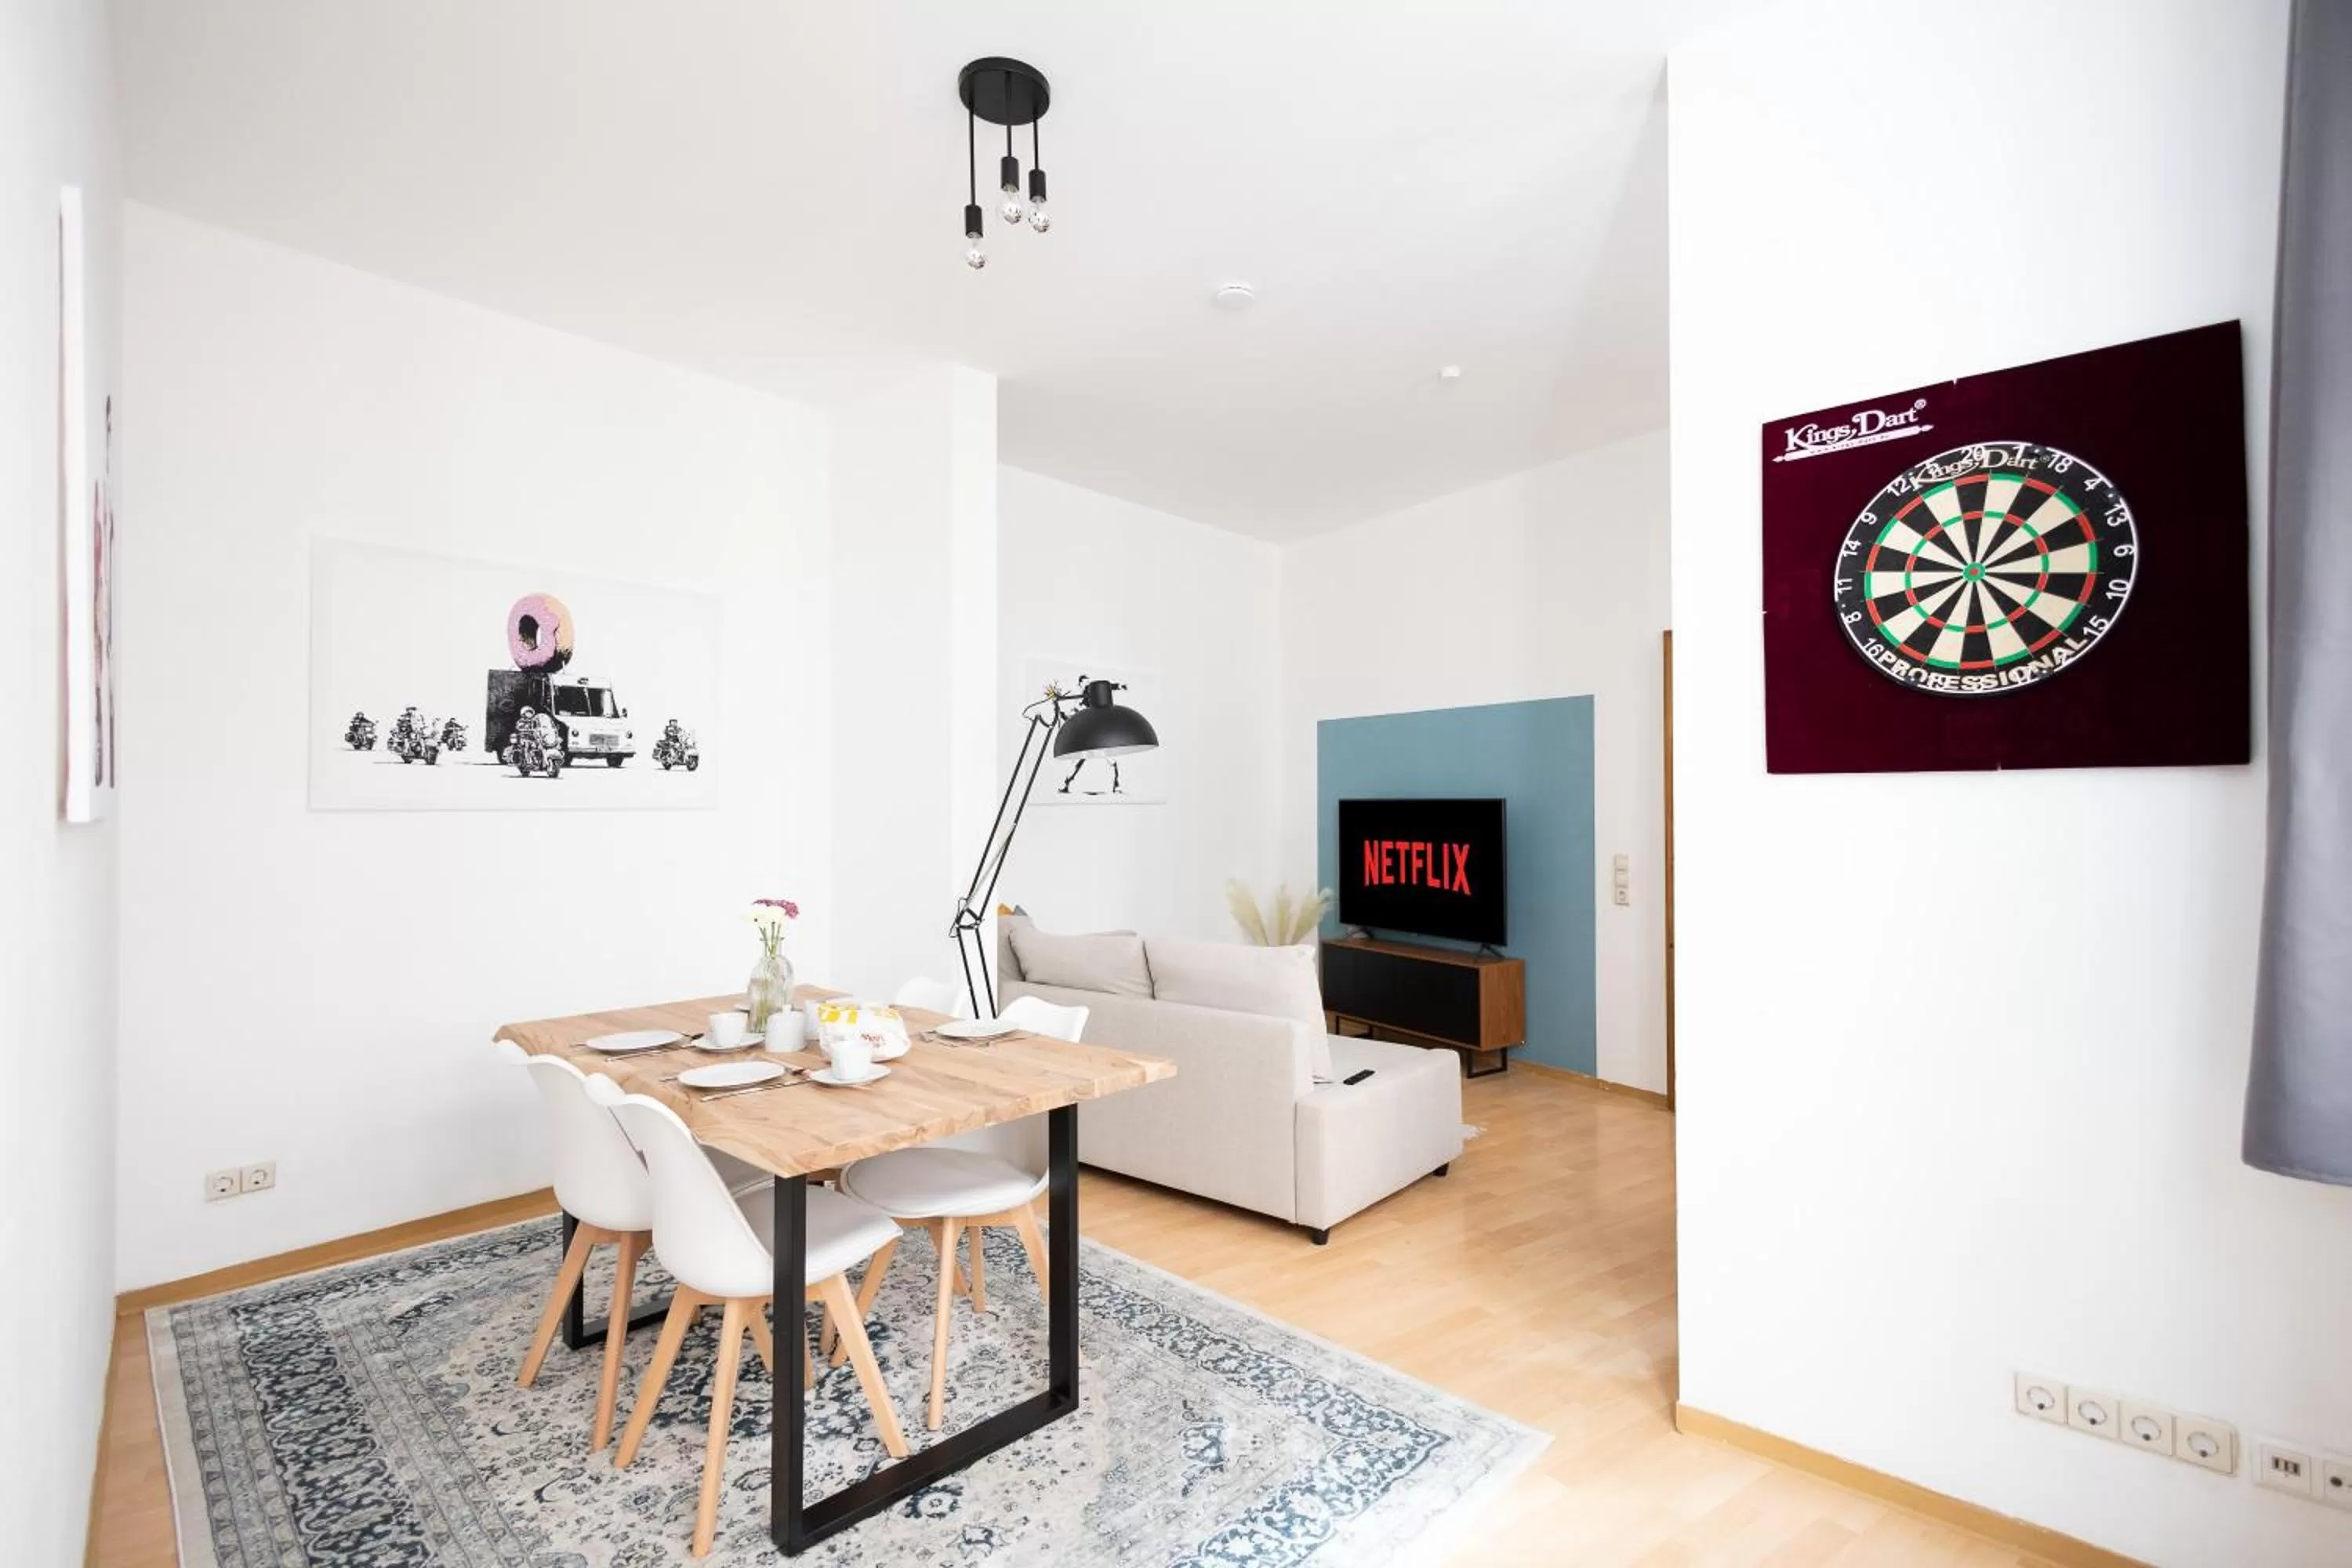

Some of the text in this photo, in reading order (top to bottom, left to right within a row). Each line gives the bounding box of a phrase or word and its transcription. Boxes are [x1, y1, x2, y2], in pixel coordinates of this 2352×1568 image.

[1960, 445, 1985, 463] 20
[2047, 453, 2074, 474] 18
[1887, 477, 1911, 496] 12
[2083, 477, 2103, 492] 4
[1860, 512, 1878, 524] 9
[2103, 503, 2128, 527] 13
[1842, 540, 1861, 557] 14
[1838, 579, 1853, 593] 11
[2106, 579, 2129, 600] 10
[1846, 611, 1862, 623] 8
[2083, 615, 2109, 636] 15
[1864, 637, 1884, 657] 16
[1878, 637, 2089, 691] PROFESSIONAL
[1364, 840, 1472, 896] NETFLIX
